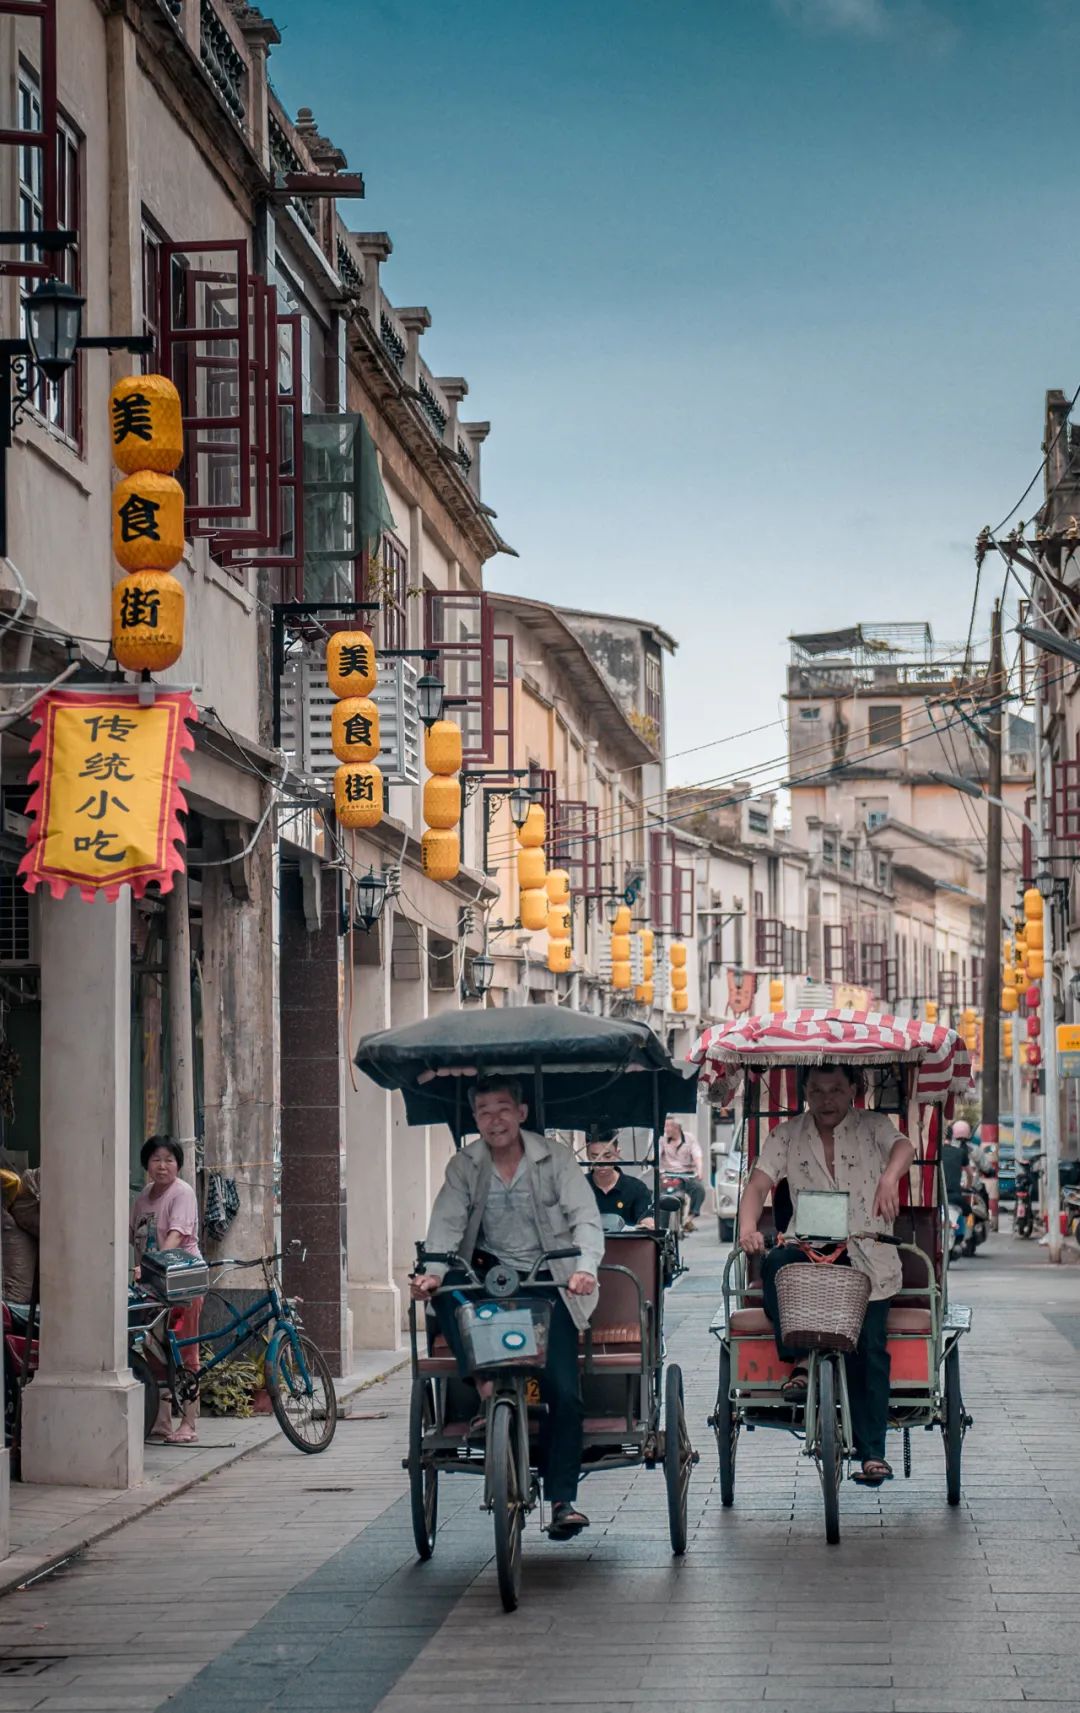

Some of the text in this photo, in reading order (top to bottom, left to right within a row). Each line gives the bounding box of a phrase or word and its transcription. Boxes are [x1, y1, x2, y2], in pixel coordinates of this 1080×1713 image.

[112, 393, 162, 629] 美食街
[74, 713, 138, 862] 传统小吃
[338, 645, 374, 802] 美食街
